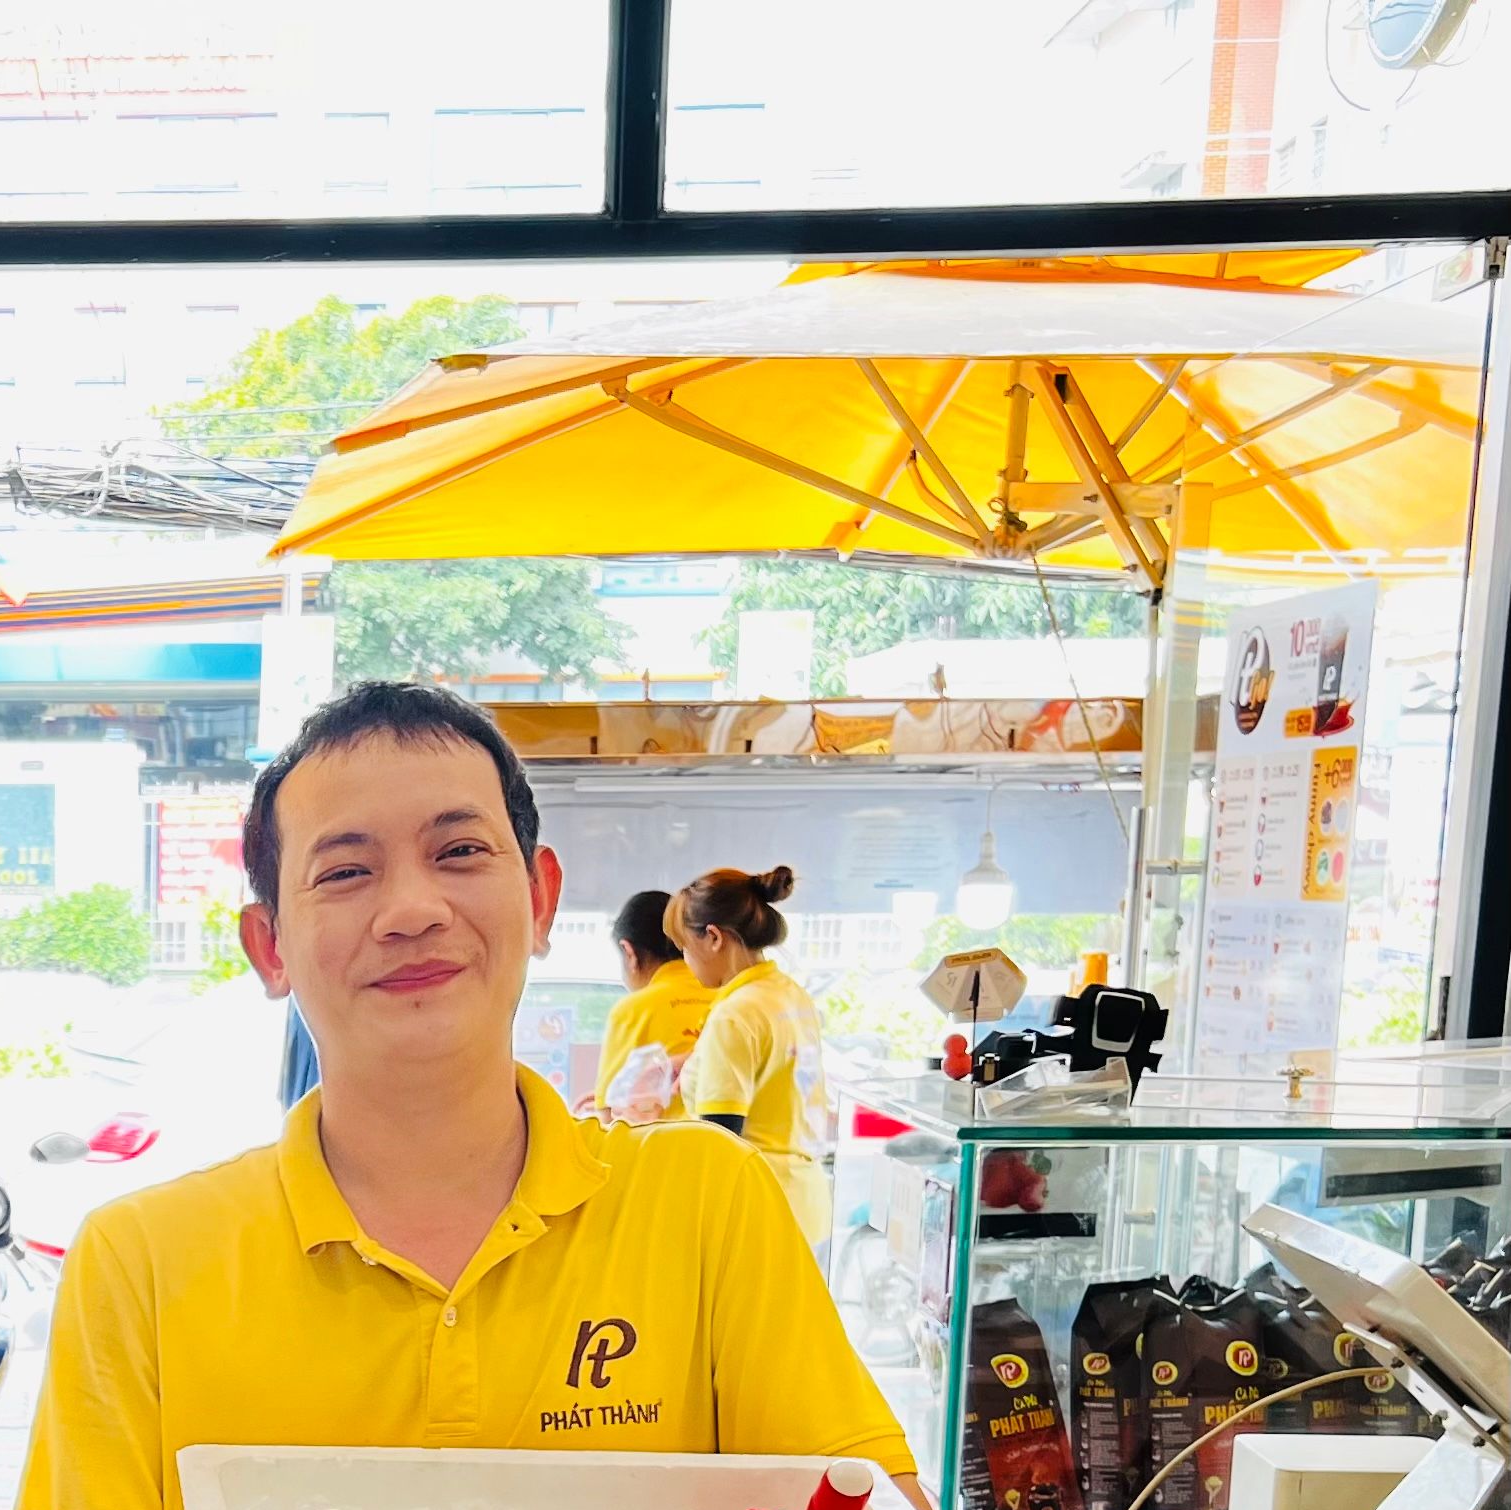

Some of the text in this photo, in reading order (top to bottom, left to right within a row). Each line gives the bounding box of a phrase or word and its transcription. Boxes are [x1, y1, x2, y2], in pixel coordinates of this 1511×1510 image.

[540, 1399, 659, 1433] PHÁT THÀNH
[990, 1410, 1026, 1438] PHÁT
